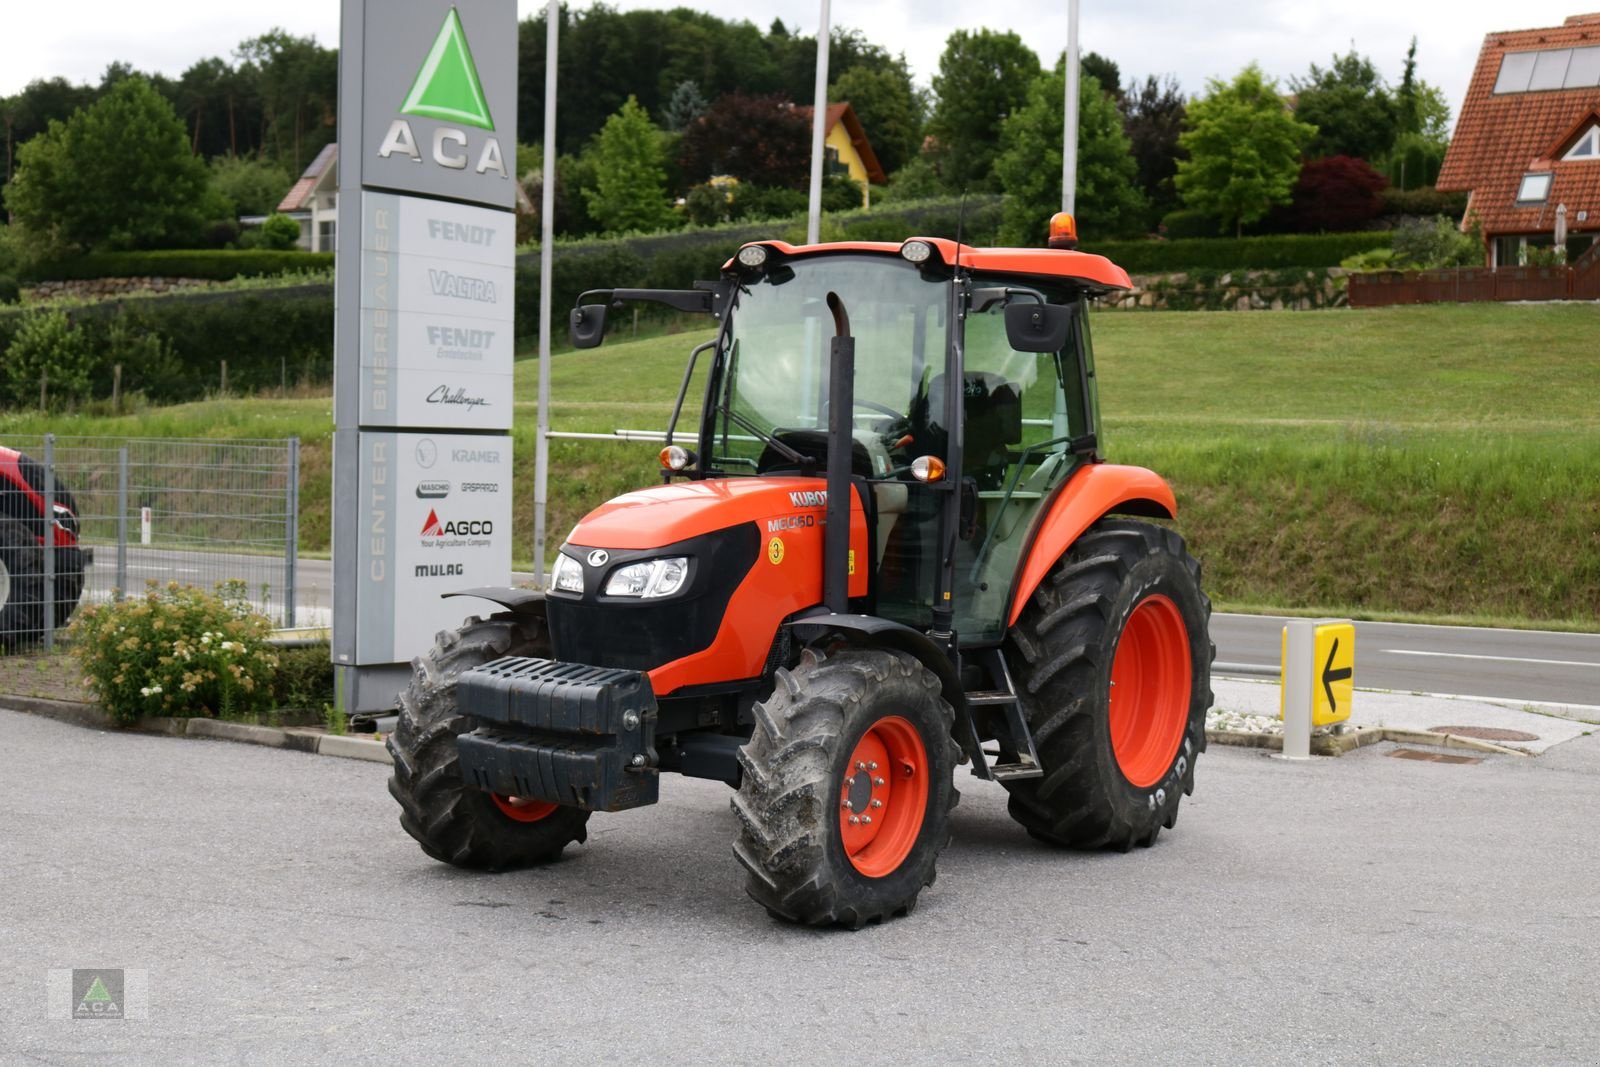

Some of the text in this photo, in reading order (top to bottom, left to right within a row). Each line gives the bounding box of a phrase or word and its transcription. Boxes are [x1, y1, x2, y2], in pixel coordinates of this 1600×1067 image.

[377, 119, 508, 179] ACA
[427, 218, 496, 247] FENDT
[428, 269, 497, 304] VALTRA
[427, 325, 496, 350] FENDT
[371, 208, 389, 582] CENTER BIERBAUER
[426, 384, 492, 412] Challenger
[451, 449, 500, 464] KRAMER
[788, 490, 827, 507] KUBOT
[444, 520, 493, 536] AGCO
[436, 539, 466, 549] Agriculture
[468, 538, 491, 548] Company
[773, 543, 779, 558] 3
[415, 563, 463, 577] MULAG
